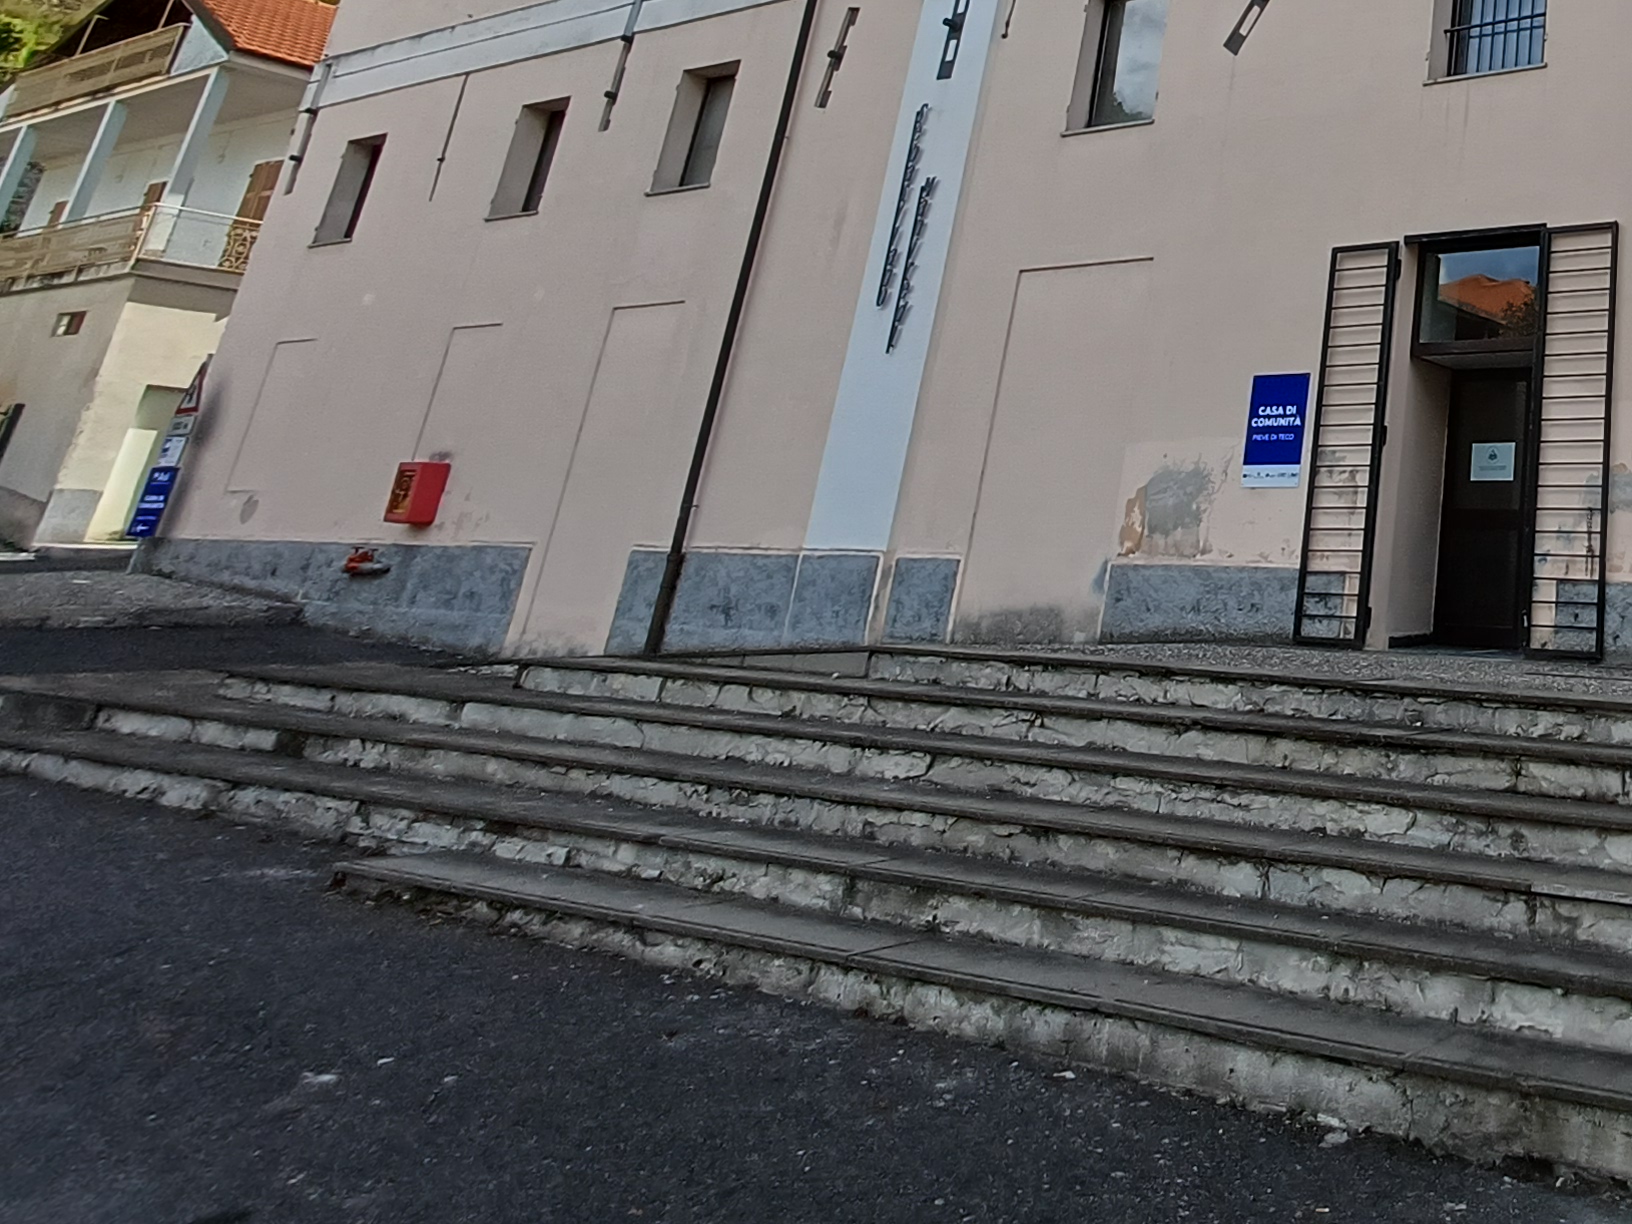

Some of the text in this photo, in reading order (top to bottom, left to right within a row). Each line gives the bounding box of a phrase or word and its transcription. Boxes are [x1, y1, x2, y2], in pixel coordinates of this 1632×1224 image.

[1258, 405, 1297, 416] CASA DI
[1251, 414, 1302, 428] COMUNITÀ
